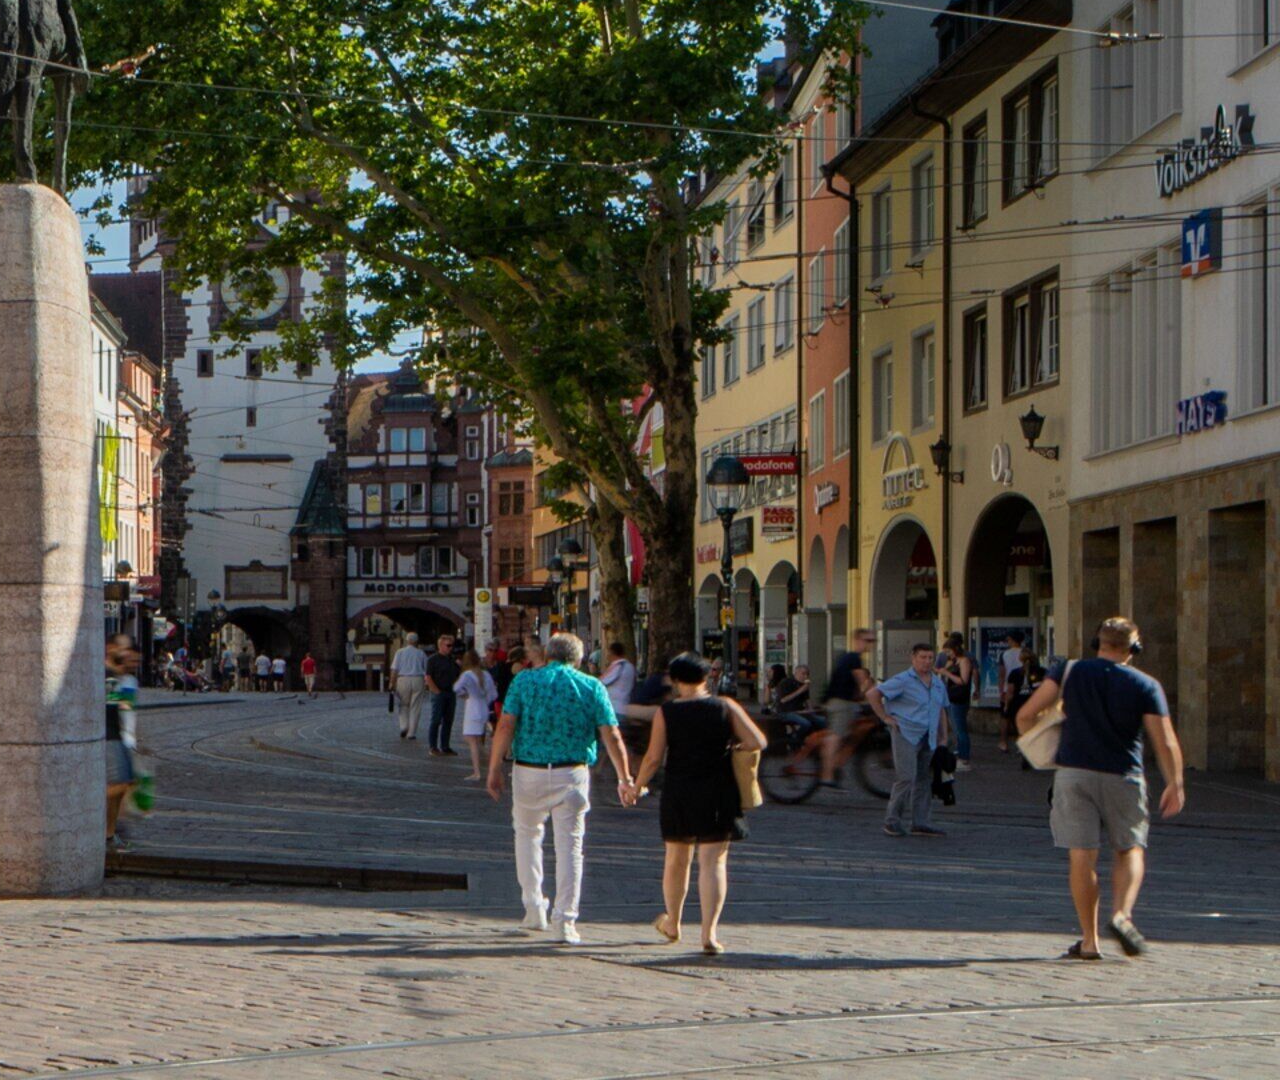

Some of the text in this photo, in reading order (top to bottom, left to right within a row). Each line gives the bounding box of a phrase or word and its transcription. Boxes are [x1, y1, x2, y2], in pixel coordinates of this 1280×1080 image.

[763, 507, 794, 515] PASS
[763, 516, 795, 524] FOTO
[364, 583, 450, 593] McDonald's
